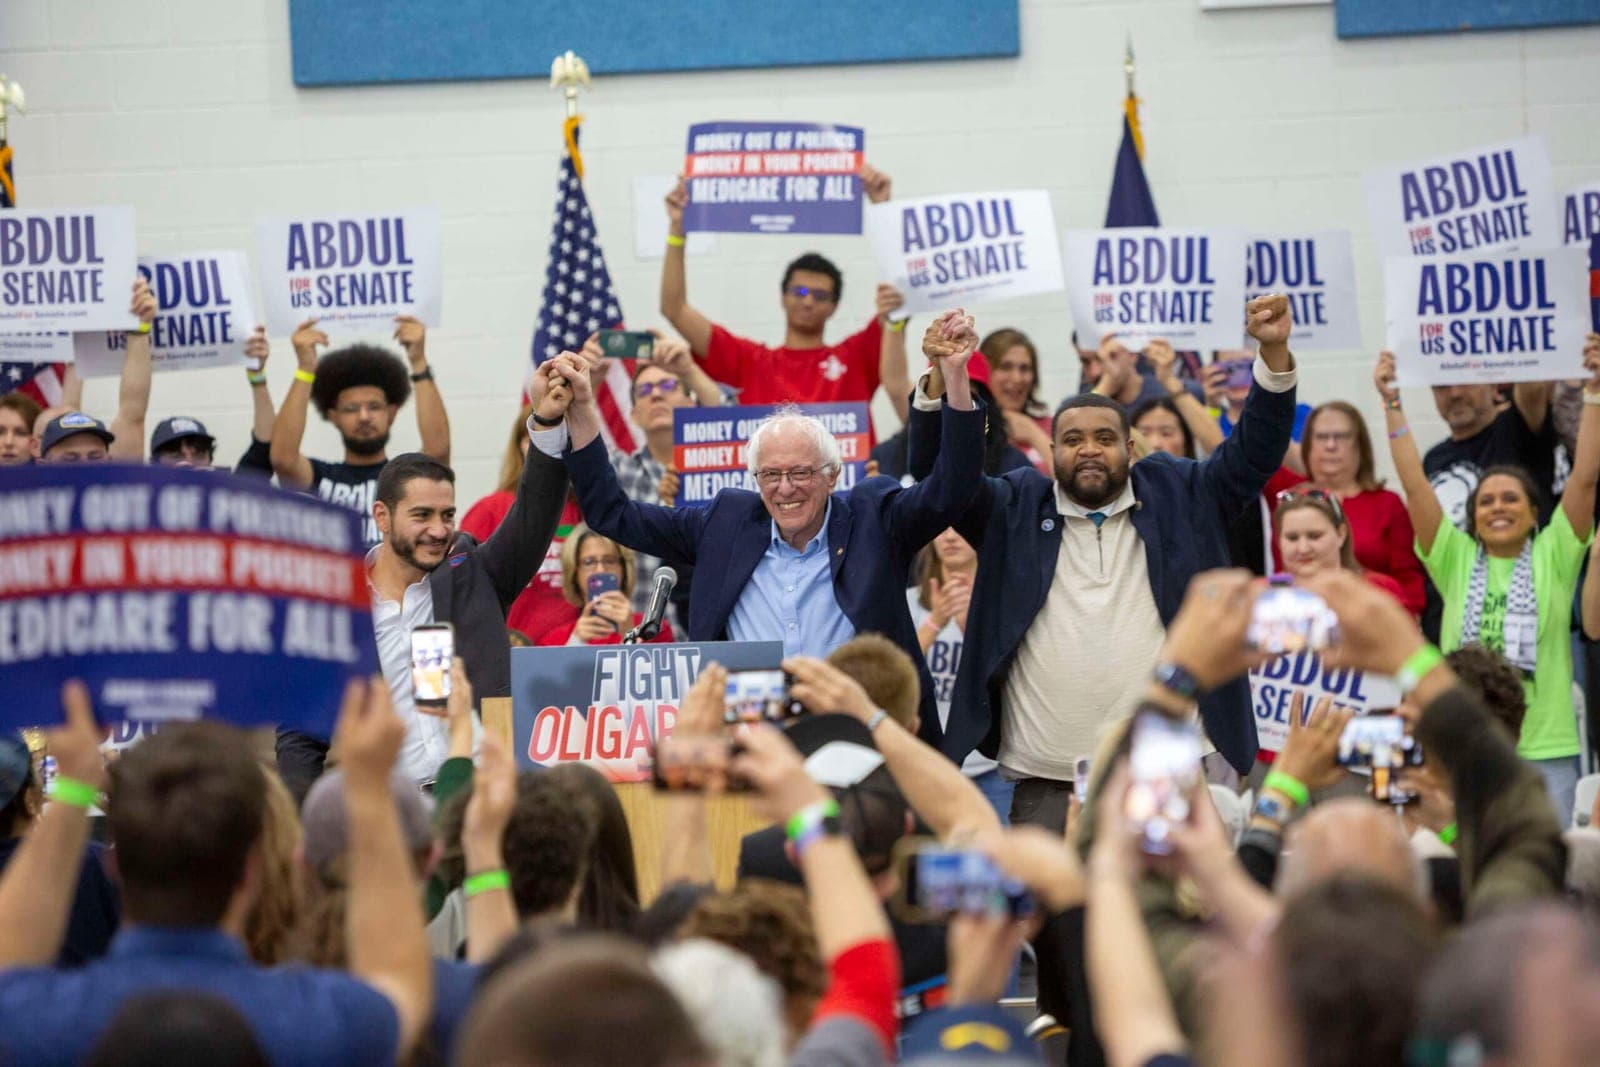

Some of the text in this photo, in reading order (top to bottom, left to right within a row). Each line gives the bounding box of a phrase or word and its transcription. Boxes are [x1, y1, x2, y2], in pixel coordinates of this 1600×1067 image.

[692, 176, 854, 203] MEDICARE FOR ALL
[1401, 150, 1527, 222] ABDUL
[0, 216, 104, 266] BDUL
[288, 218, 413, 271] ABDUL
[902, 198, 1023, 253] ABDUL
[1409, 226, 1432, 247] FOR
[1437, 203, 1531, 253] SENATE
[138, 259, 232, 310] DUL
[290, 277, 311, 292] FOR
[910, 241, 1027, 288] US SENATE
[1093, 236, 1215, 286] ABDUL
[2, 270, 104, 306] SENATE
[291, 270, 414, 308] US SENATE
[1095, 291, 1213, 324] US SENATE
[1417, 258, 1556, 316] ABDUL
[149, 312, 234, 348] ENATE
[1420, 323, 1443, 338] FOR
[1421, 316, 1557, 355] US SENATE
[683, 421, 734, 443] MONEY
[684, 446, 734, 470] MONEY
[81, 485, 150, 530] OUT
[684, 470, 758, 501] MEDICA
[131, 537, 225, 585] YOUR
[0, 593, 358, 664] EDICARE FOR ALL
[592, 647, 700, 702] FIGHT
[1249, 648, 1367, 703] BDUL
[528, 703, 681, 763] OLIGAR
